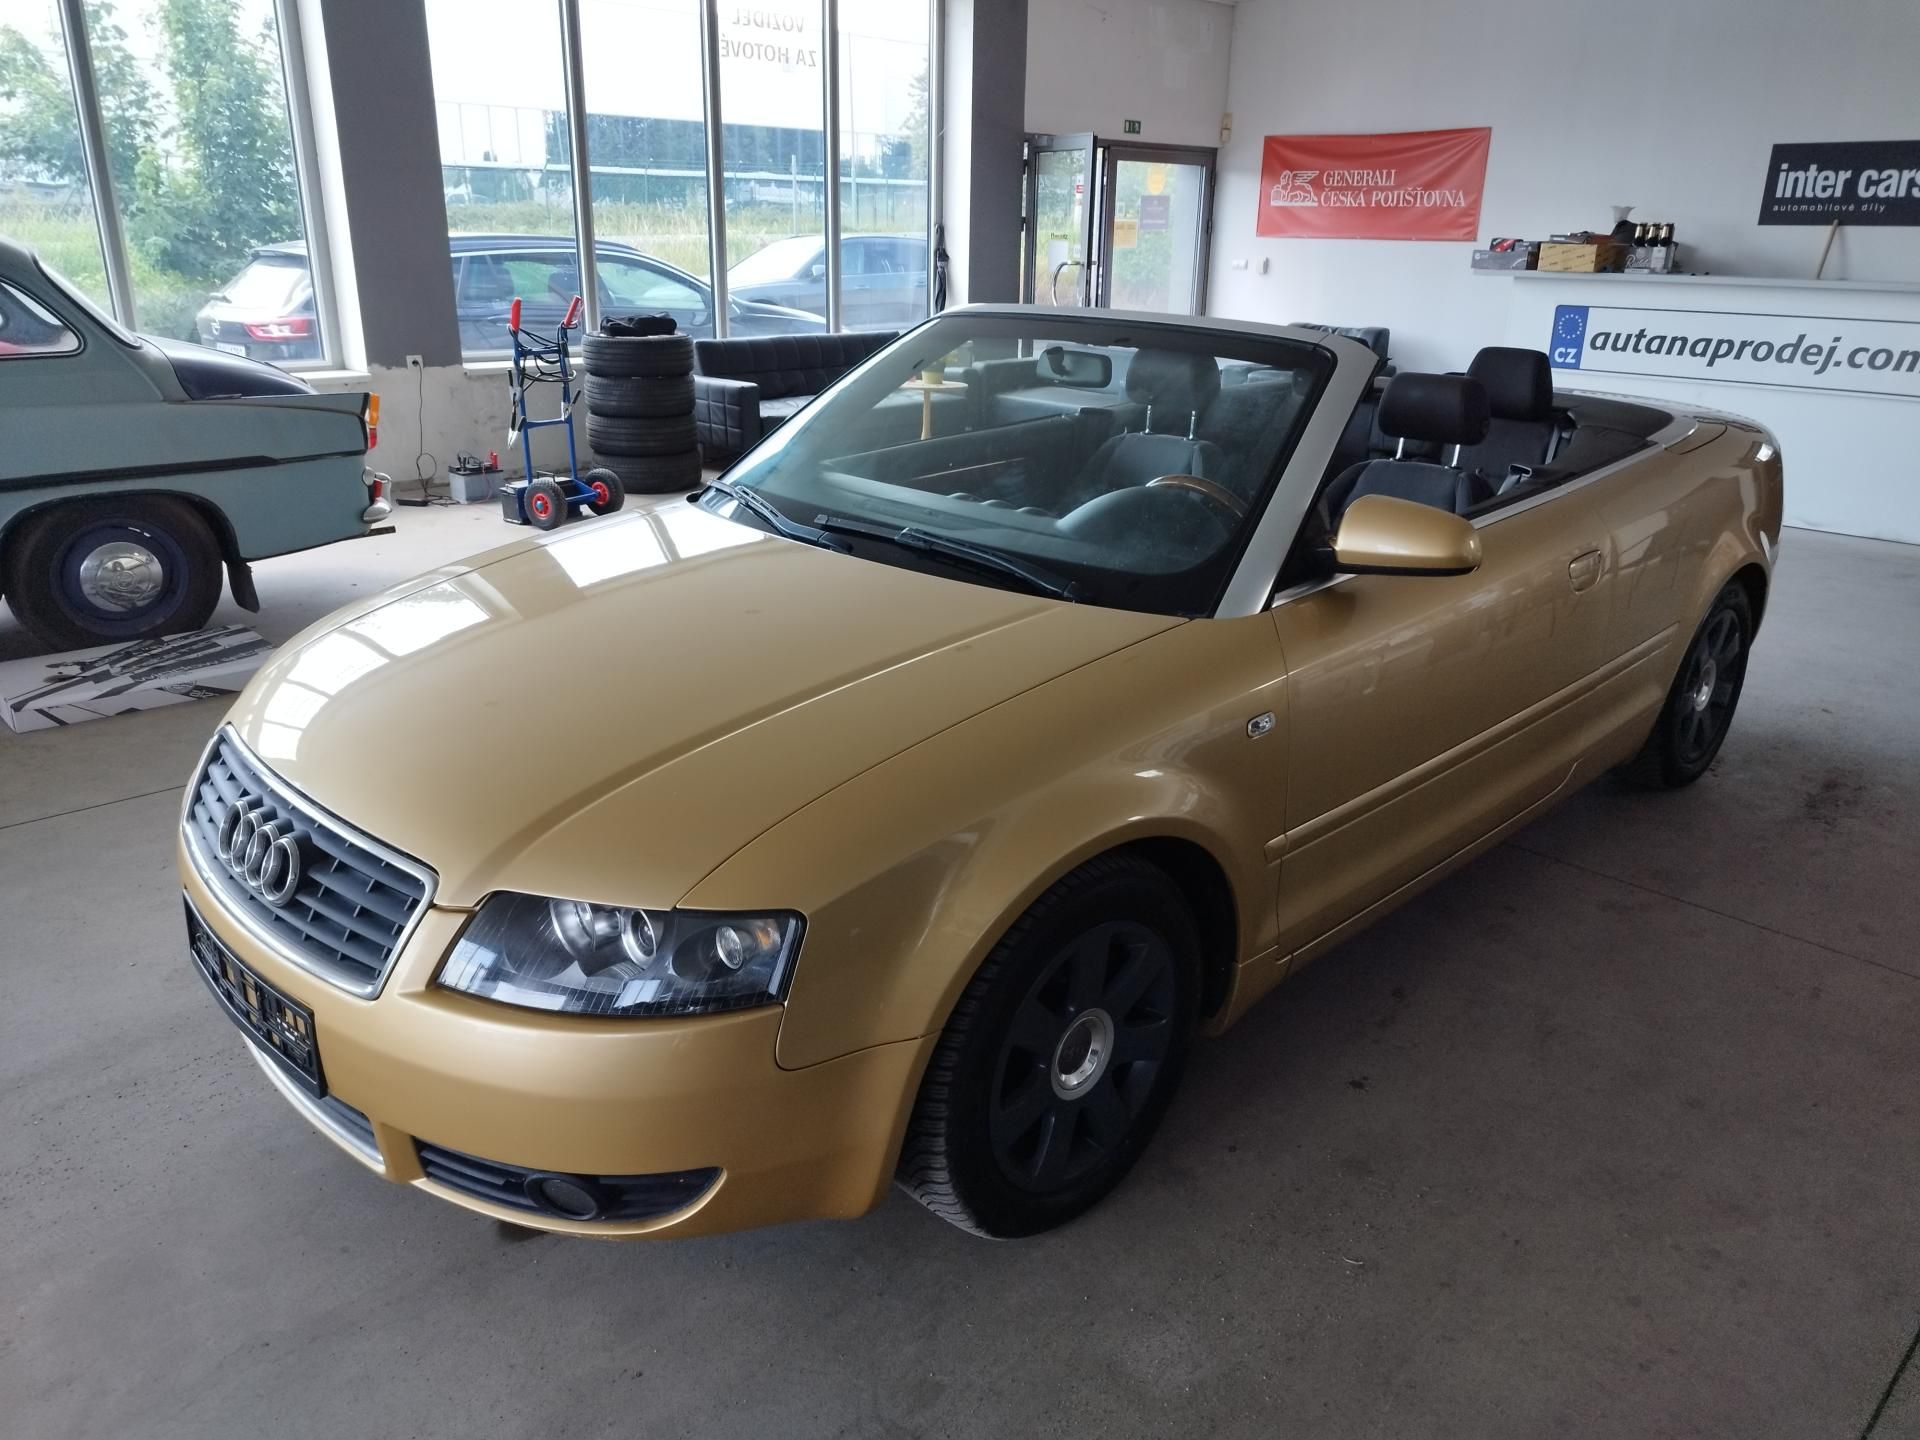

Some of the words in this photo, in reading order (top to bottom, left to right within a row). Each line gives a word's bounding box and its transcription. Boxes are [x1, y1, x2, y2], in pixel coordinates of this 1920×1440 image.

[1323, 169, 1396, 186] GENERALI
[1775, 163, 1852, 198] inter
[1321, 188, 1367, 207] ČESKÁ
[1371, 187, 1466, 208] POJIŠŤOVNA
[1772, 203, 1855, 212] automobilové
[1554, 347, 1578, 364] CZ
